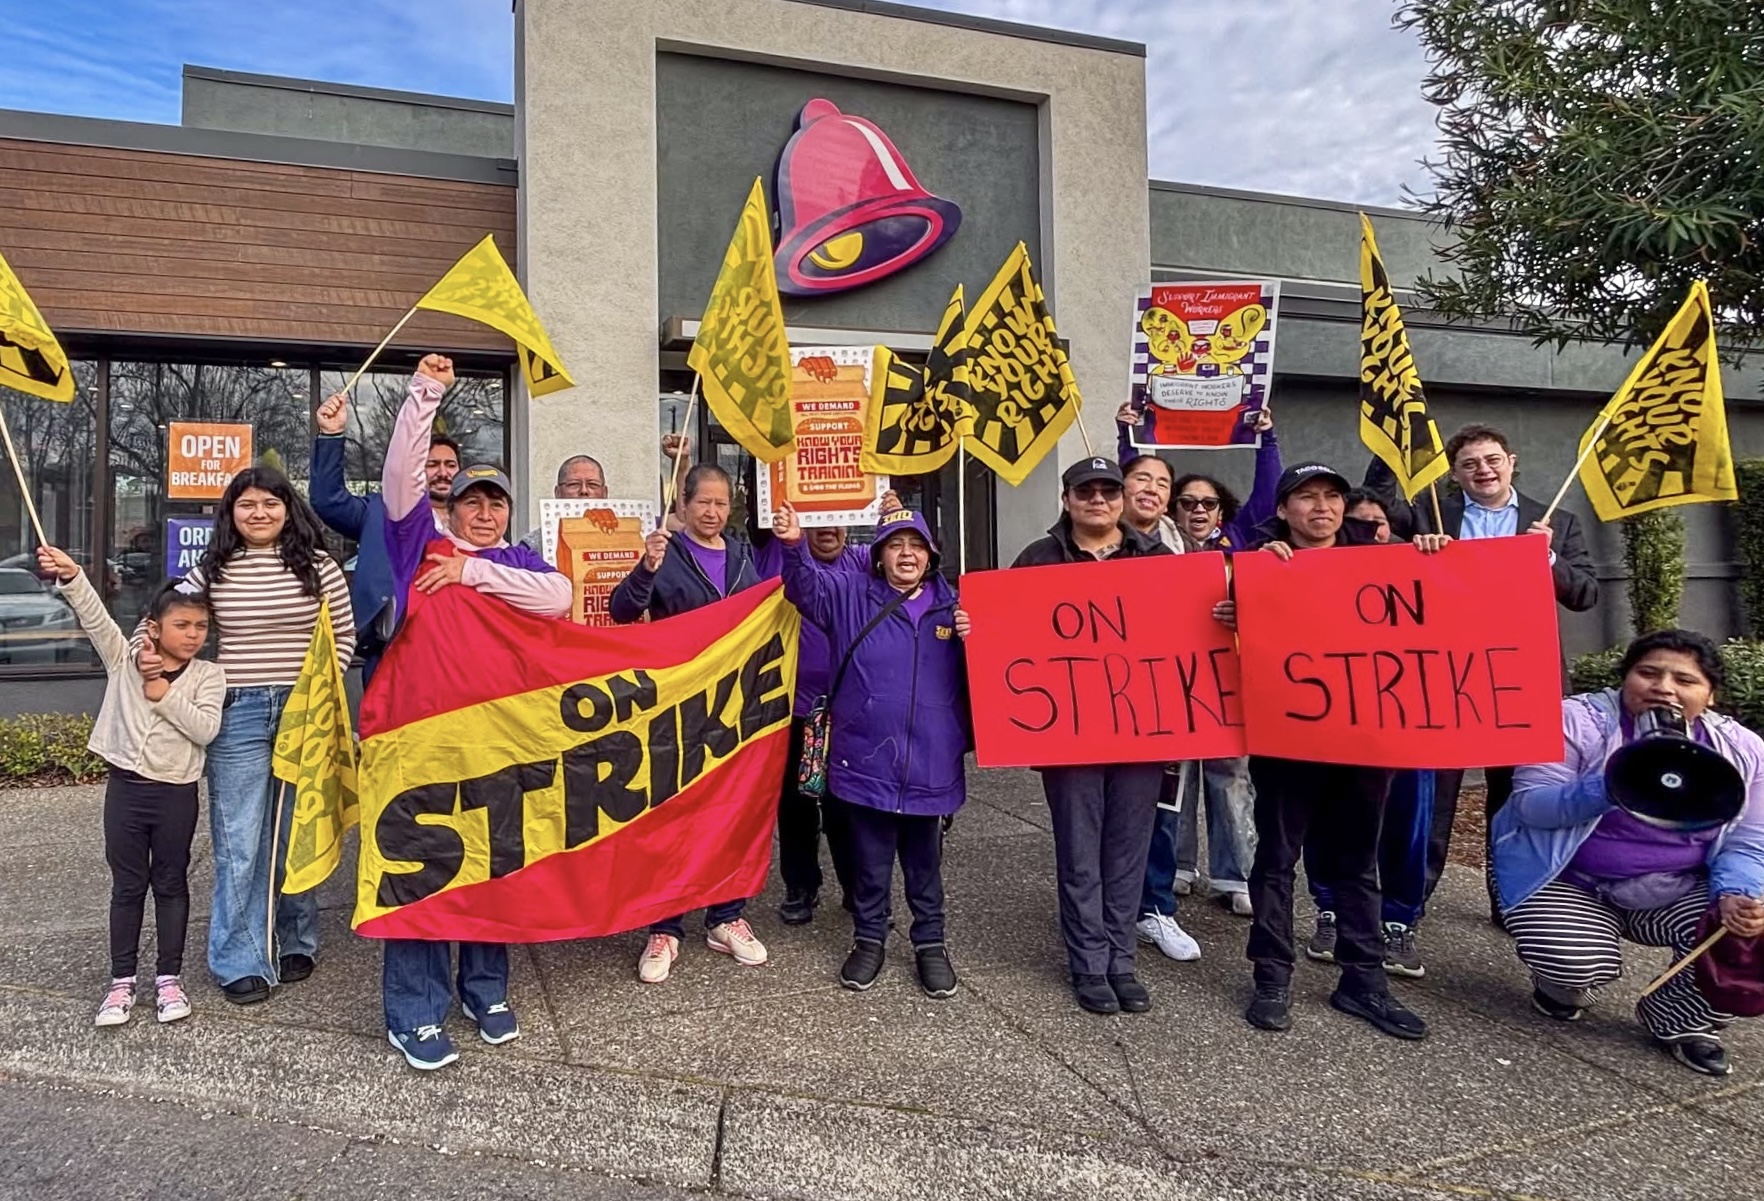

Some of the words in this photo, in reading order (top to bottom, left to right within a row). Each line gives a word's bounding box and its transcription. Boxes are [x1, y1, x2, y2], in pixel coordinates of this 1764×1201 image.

[987, 322, 1052, 400] YOUR
[996, 353, 1059, 428] RIGH
[818, 402, 854, 411] DEMAND
[1185, 398, 1227, 407] RIGHTS
[810, 422, 849, 431] SUPPORT
[181, 435, 241, 458] OPEN
[796, 437, 830, 447] KNOW
[201, 460, 220, 470] FOR
[1295, 466, 1318, 474] TACO
[172, 472, 234, 486] BREAKFA
[588, 552, 602, 560] WE
[604, 551, 634, 559] DEMAND
[1356, 580, 1424, 626] ON
[1052, 596, 1126, 643] ON
[1005, 647, 1244, 736] STRIKE
[1284, 648, 1531, 729] STRIKE
[560, 670, 658, 732] ON
[375, 632, 790, 907] STRIKE
